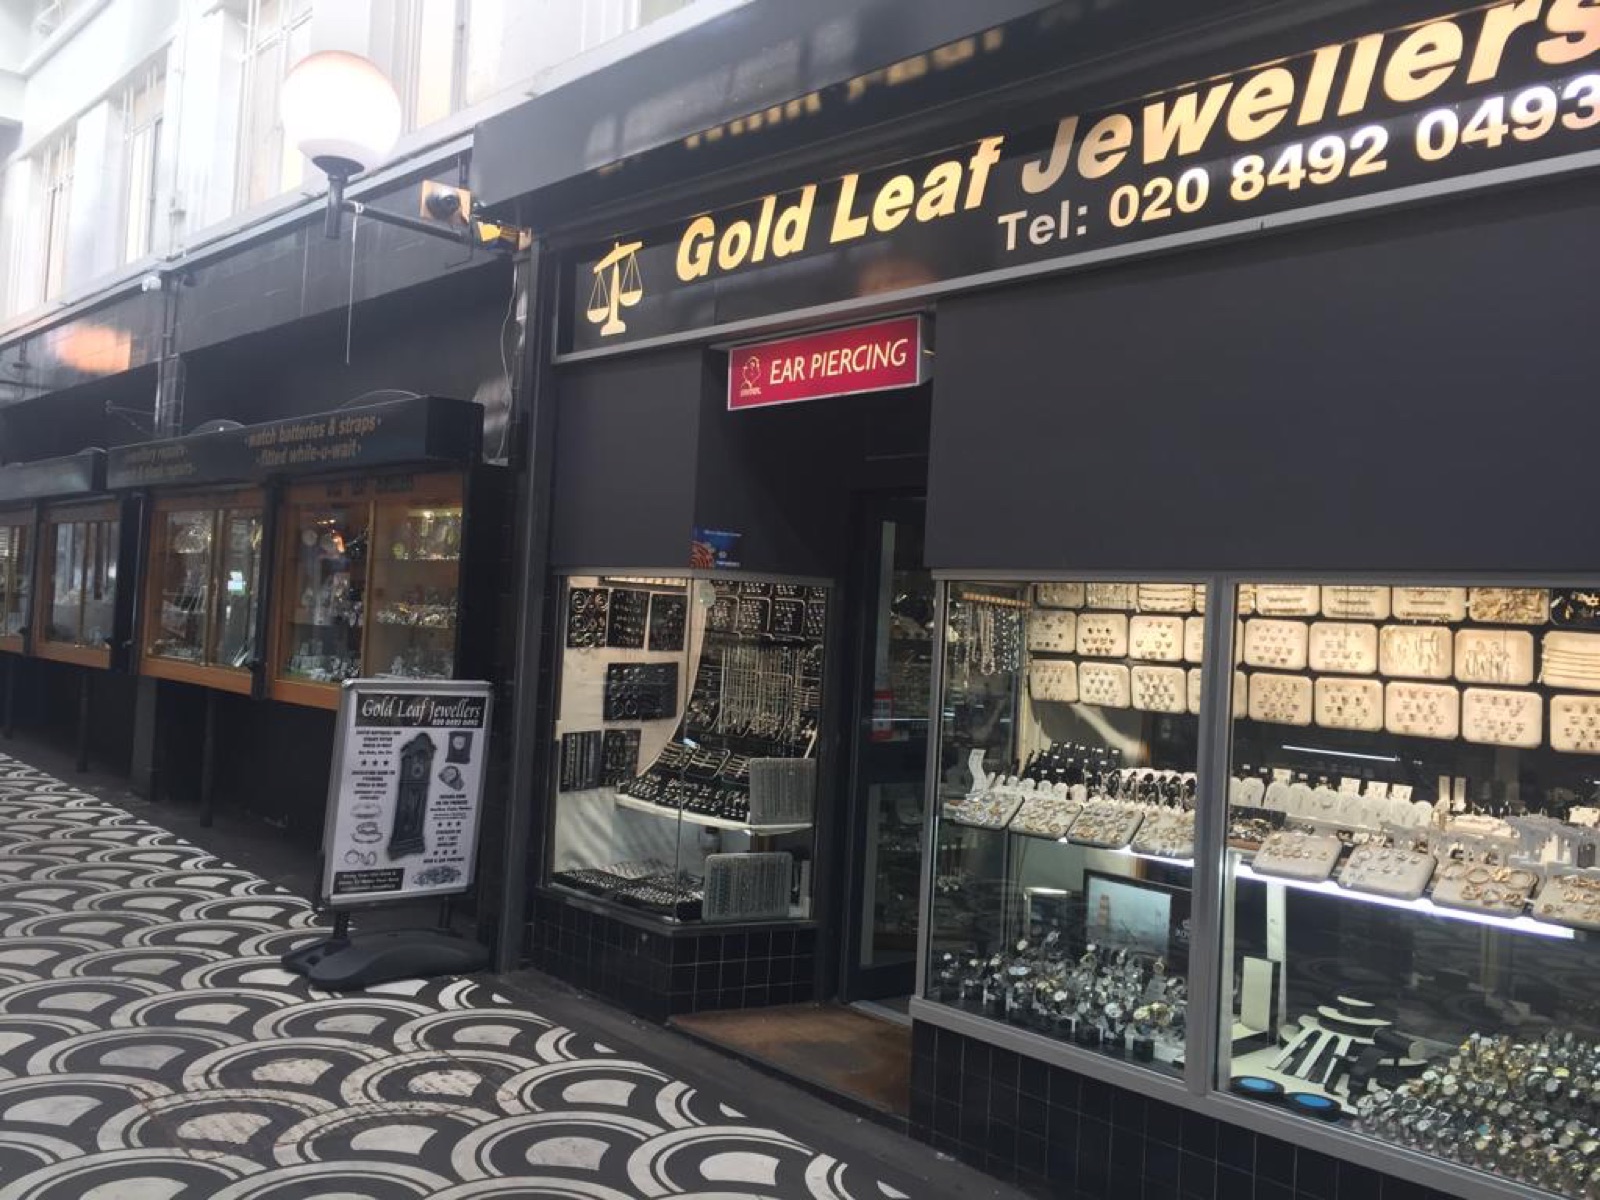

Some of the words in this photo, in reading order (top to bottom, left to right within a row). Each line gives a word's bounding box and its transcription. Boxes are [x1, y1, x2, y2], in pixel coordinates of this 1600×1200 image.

[676, 184, 817, 282] Gold
[829, 135, 1004, 245] Leaf
[1021, 0, 1600, 194] Jewellers
[997, 202, 1088, 251] Tel:
[1108, 167, 1210, 228] 020
[1230, 125, 1389, 202] 8492
[1415, 74, 1600, 162] 0493
[769, 356, 805, 386] EAR
[811, 338, 908, 379] PIERCING
[279, 423, 326, 443] batteries
[338, 415, 377, 437] straps
[362, 696, 397, 717] Gold
[398, 697, 430, 726] Leaf
[429, 698, 480, 721] Jewellers
